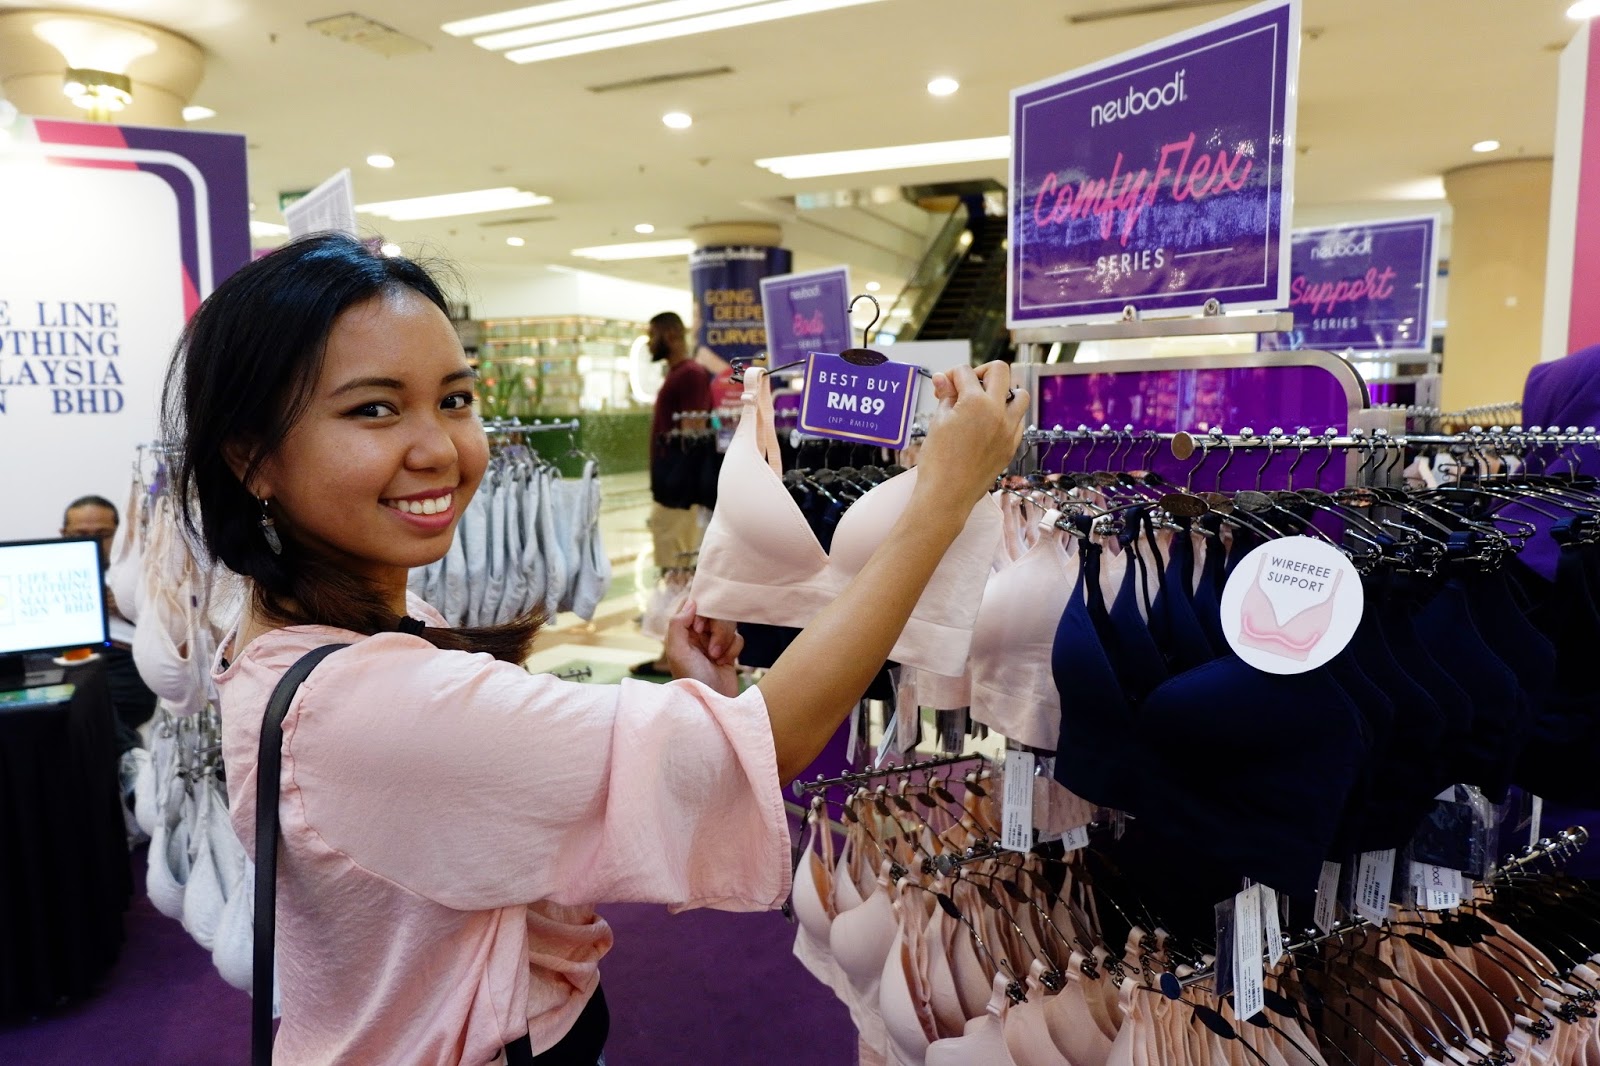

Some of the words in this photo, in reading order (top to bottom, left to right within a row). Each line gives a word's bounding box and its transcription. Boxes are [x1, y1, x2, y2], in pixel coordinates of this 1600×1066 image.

[1091, 68, 1187, 127] neubodi
[1033, 131, 1254, 247] ComfyFlex
[1311, 233, 1372, 260] neubodi
[1096, 248, 1164, 276] SERIES
[1290, 265, 1397, 316] Support
[37, 301, 119, 328] LINE
[1312, 317, 1358, 331] SERIES
[818, 371, 859, 388] BEST
[867, 378, 900, 394] BUY
[52, 388, 125, 415] BHD
[1271, 556, 1332, 579] WIREFREE
[1267, 571, 1325, 593] SUPPORT
